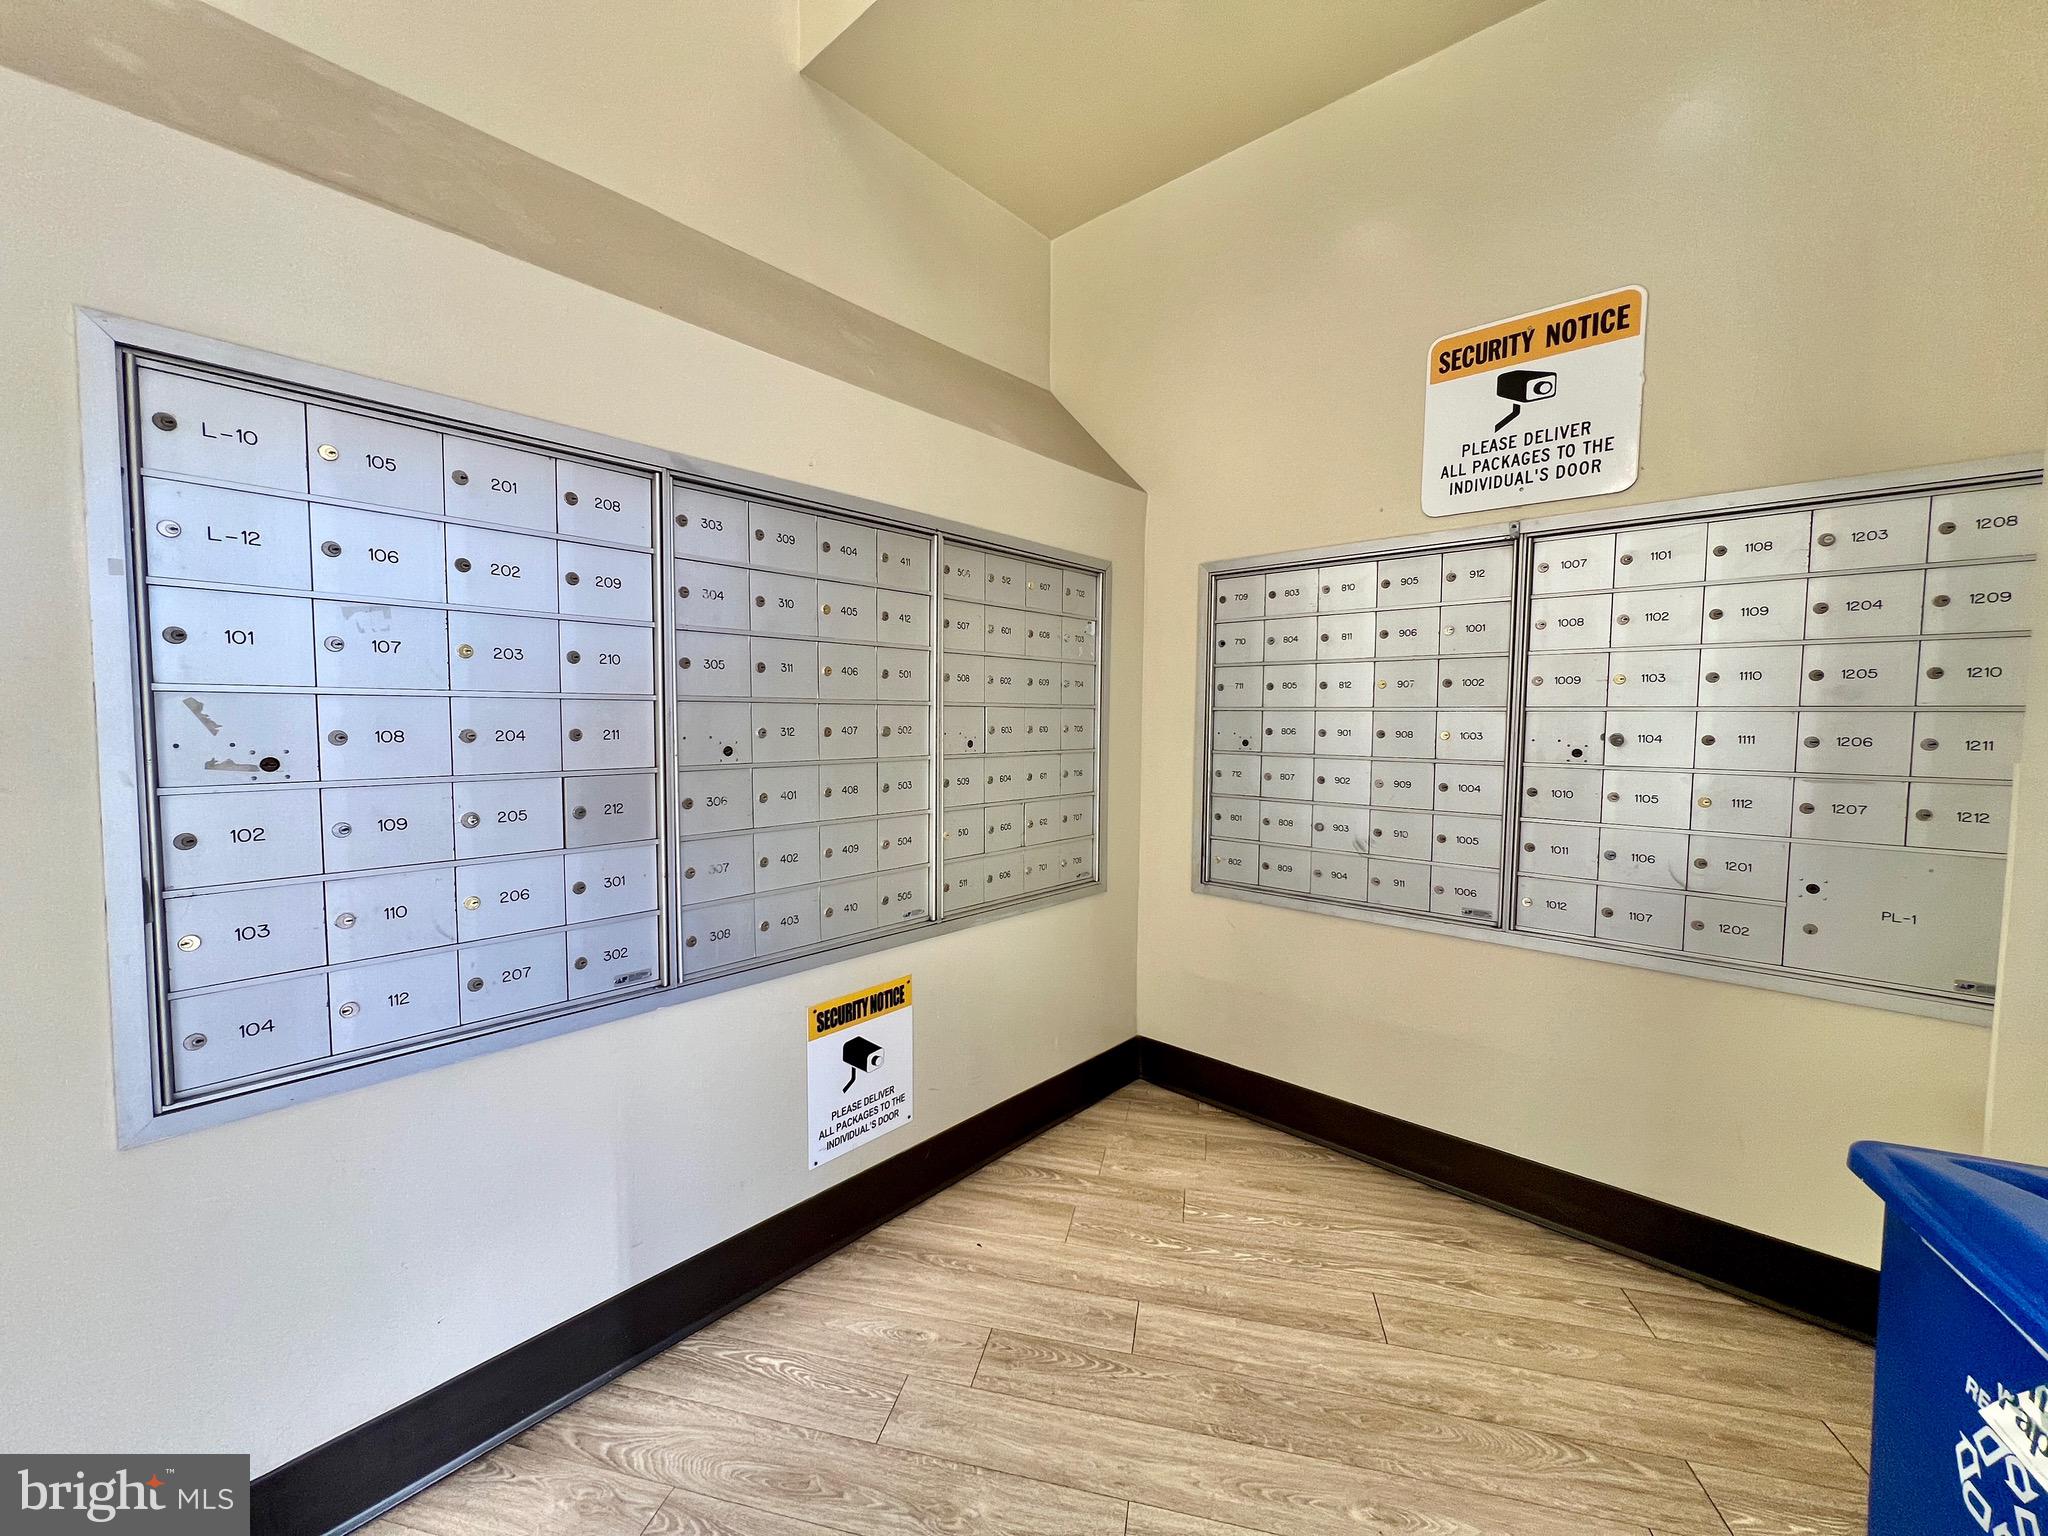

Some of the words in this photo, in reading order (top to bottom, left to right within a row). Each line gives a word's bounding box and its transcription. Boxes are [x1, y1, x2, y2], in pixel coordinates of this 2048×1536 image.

[1439, 328, 1535, 374] SECURITY
[1546, 304, 1630, 348] NOTICE
[202, 421, 258, 446] L-10
[1462, 435, 1517, 458] PLEASE
[1524, 421, 1591, 447] DELIVER
[365, 454, 397, 472] 105
[1441, 462, 1466, 480] ALL
[1472, 448, 1550, 474] PACKAGES
[1557, 443, 1576, 459] TO
[1583, 436, 1615, 455] THE
[1449, 468, 1549, 496] INDIVIDUAL'S
[1556, 459, 1602, 480] DOOR
[490, 478, 517, 495] 201
[594, 497, 621, 513] 208
[701, 518, 723, 531] 303
[1976, 515, 2018, 530] 1208
[207, 526, 262, 547] L-12
[776, 533, 795, 545] 309
[1851, 529, 1888, 543] 1203
[840, 546, 857, 556] 404
[1745, 540, 1773, 553] 1108
[368, 548, 399, 564] 106
[1651, 550, 1672, 561] 1101
[900, 557, 911, 566] 411
[1561, 558, 1587, 570] 1007
[490, 563, 521, 579] 202
[1469, 569, 1485, 579] 912
[595, 575, 622, 589] 209
[1040, 583, 1050, 591] 607
[1400, 577, 1419, 586] 905
[1285, 589, 1300, 597] 803
[1341, 584, 1355, 592] 810
[702, 589, 724, 601] 304
[1234, 593, 1248, 601] 709
[1969, 591, 2012, 605] 1209
[778, 598, 794, 609] 310
[1846, 599, 1883, 612] 1204
[840, 606, 857, 616] 405
[1645, 611, 1669, 622] 1102
[1741, 605, 1769, 617] 1109
[899, 614, 911, 623] 412
[1557, 617, 1585, 628] 1008
[957, 622, 969, 630] 507
[1001, 627, 1011, 635] 601
[1466, 624, 1486, 633] 1001
[224, 629, 254, 646] 101
[1341, 633, 1352, 641] 811
[1399, 628, 1417, 637] 906
[1283, 636, 1298, 644] 804
[371, 639, 402, 654] 107
[493, 647, 524, 661] 203
[599, 653, 621, 666] 210
[704, 659, 725, 670] 305
[781, 663, 793, 672] 311
[841, 667, 858, 676] 406
[899, 670, 911, 678] 501
[1739, 670, 1762, 681] 1110
[1841, 668, 1878, 680] 1205
[1966, 666, 2002, 678] 1210
[957, 674, 969, 682] 508
[1462, 678, 1484, 687] 1002
[1554, 675, 1582, 685] 1009
[1641, 673, 1666, 683] 1103
[1339, 681, 1352, 689] 812
[1397, 680, 1415, 689] 907
[602, 730, 620, 740] 211
[780, 727, 795, 737] 312
[841, 726, 858, 735] 407
[898, 726, 912, 734] 502
[1281, 728, 1296, 736] 806
[1337, 729, 1351, 737] 901
[1395, 730, 1413, 739] 908
[1460, 731, 1483, 740] 1003
[374, 729, 405, 744] 108
[495, 730, 526, 742] 204
[1637, 734, 1663, 744] 1104
[1737, 734, 1756, 745] 1111
[1837, 736, 1873, 748] 1206
[1965, 740, 1994, 752] 1211
[957, 777, 969, 785] 509
[1280, 773, 1295, 781] 807
[1334, 776, 1350, 785] 902
[842, 785, 858, 794] 408
[898, 781, 912, 790] 503
[1393, 780, 1411, 789] 909
[1458, 784, 1481, 793] 1004
[780, 790, 797, 800] 401
[1551, 789, 1574, 799] 1010
[1634, 793, 1659, 804] 1105
[706, 796, 727, 807] 306
[1731, 798, 1753, 809] 1112
[604, 803, 624, 815] 212
[1831, 803, 1867, 815] 1207
[497, 809, 528, 823] 205
[1957, 811, 1990, 824] 1212
[377, 817, 408, 832] 109
[1278, 819, 1293, 827] 808
[1333, 824, 1349, 833] 903
[230, 827, 266, 844] 102
[958, 828, 968, 836] 510
[1394, 830, 1408, 839] 910
[898, 837, 912, 846] 504
[1456, 835, 1479, 845] 1005
[842, 844, 859, 853] 409
[1550, 845, 1569, 855] 1011
[780, 853, 798, 863] 402
[1228, 858, 1242, 866] 802
[1631, 853, 1656, 864] 1106
[1277, 864, 1292, 873] 809
[1725, 861, 1752, 873] 1201
[1331, 871, 1348, 880] 904
[604, 875, 626, 888] 301
[959, 879, 967, 887] 511
[1393, 879, 1405, 888] 911
[500, 889, 530, 904] 206
[898, 891, 912, 901] 505
[1454, 887, 1477, 898] 1006
[844, 903, 858, 912] 410
[1546, 900, 1567, 911] 1012
[383, 905, 408, 920] 110
[1628, 911, 1653, 923] 1107
[1881, 911, 1917, 925] PL-1
[780, 915, 799, 926] 403
[234, 923, 271, 942] 103
[710, 929, 730, 941] 308
[1719, 924, 1750, 936] 1202
[603, 947, 628, 961] 302
[502, 966, 531, 983] 207
[388, 992, 410, 1007] 112
[816, 995, 869, 1032] SECURITY
[870, 985, 905, 1014] NOTICE
[239, 1019, 275, 1038] 104
[831, 1098, 862, 1121] PLEASE
[864, 1085, 895, 1106] DELIVER
[818, 1124, 834, 1141] ALL
[836, 1106, 879, 1131] PACKAGES
[880, 1102, 890, 1113] TO
[892, 1093, 906, 1107] THE
[826, 1120, 877, 1151] INDIVIDUAL'S
[878, 1109, 899, 1126] DOOR
